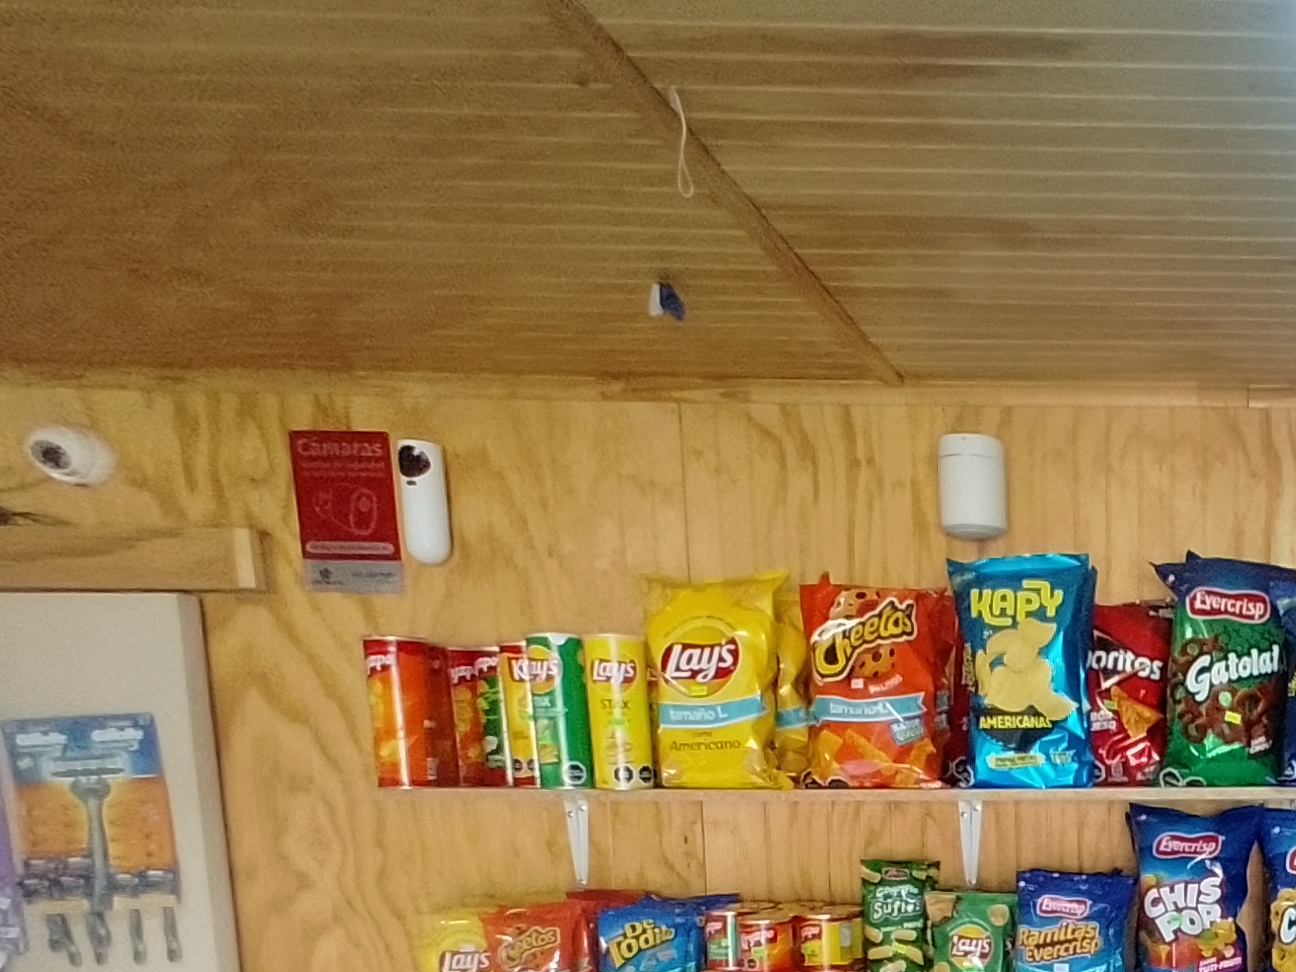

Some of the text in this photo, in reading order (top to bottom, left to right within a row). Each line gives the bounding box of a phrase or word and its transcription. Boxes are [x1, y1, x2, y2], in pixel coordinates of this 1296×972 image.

[298, 436, 384, 457] Cámaras
[971, 581, 1064, 627] KAPY
[1194, 590, 1265, 619] Evercrisp
[813, 599, 917, 677] Cheetos
[664, 639, 738, 684] Lay's
[600, 699, 630, 710] STX
[669, 706, 729, 722] tamaño L
[979, 715, 1053, 730] AMERICANAS
[670, 738, 741, 752] Americano
[1157, 834, 1222, 857] Evercrisp
[1143, 877, 1223, 919] CHIS
[624, 919, 655, 939] De
[1019, 920, 1098, 946] Ramitas
[1156, 903, 1222, 943] POP
[607, 926, 676, 968] Todito
[1025, 937, 1101, 962] Evercrisp
